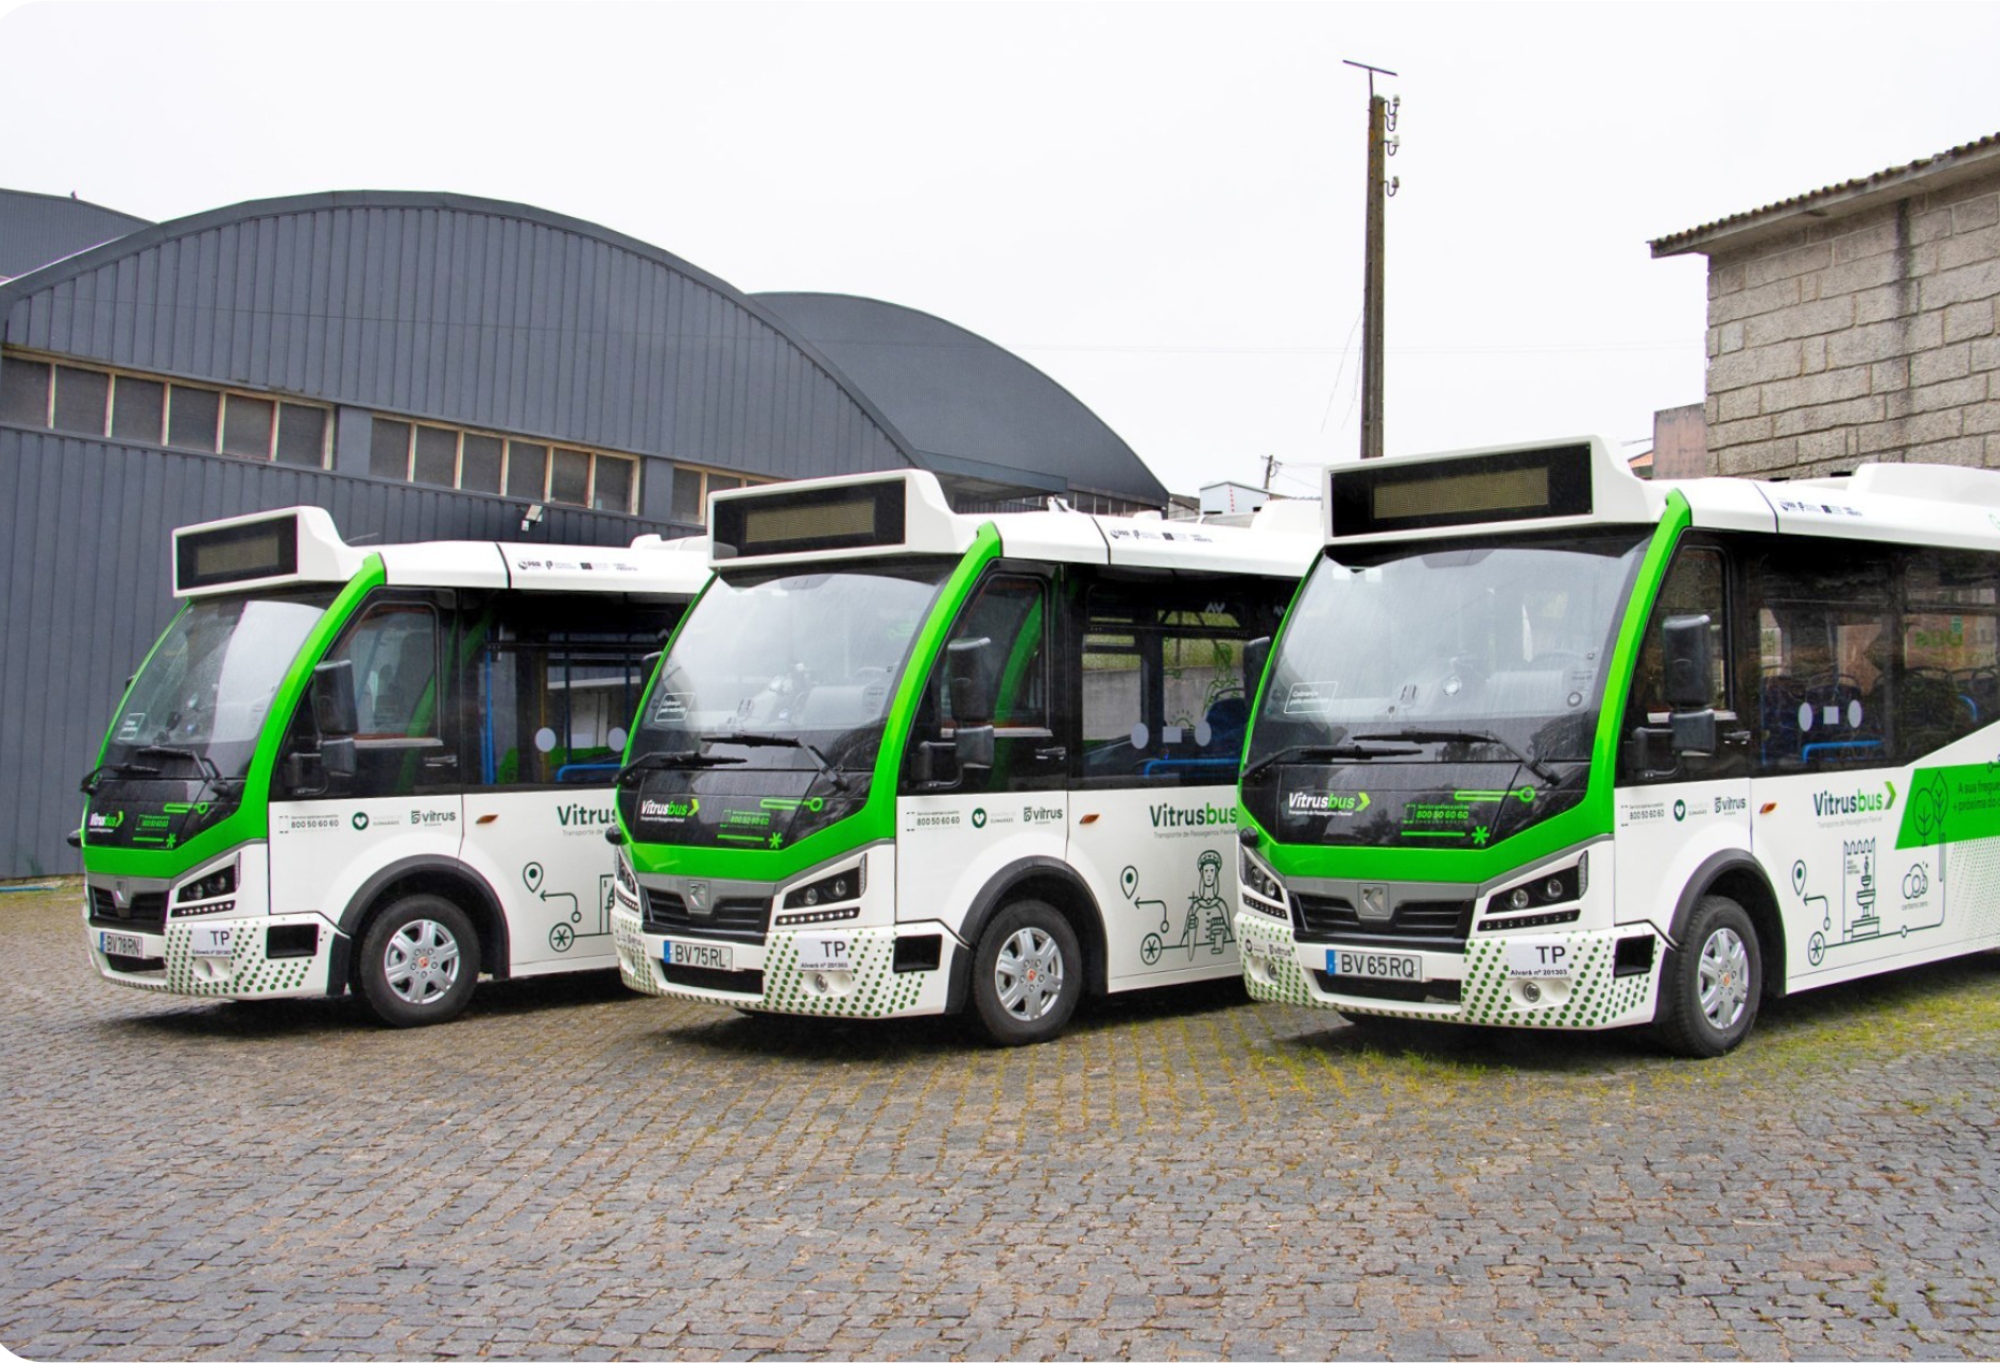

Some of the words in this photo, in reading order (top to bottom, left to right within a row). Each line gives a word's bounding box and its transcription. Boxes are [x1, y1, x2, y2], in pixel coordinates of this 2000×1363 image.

[641, 799, 688, 816] Vitrusbus
[1289, 792, 1355, 809] Vitrusbus
[1813, 788, 1883, 817] Vitrusbus
[917, 817, 930, 826] 800
[931, 817, 940, 825] 50
[941, 816, 950, 825] 60
[951, 816, 960, 824] 60
[1149, 802, 1238, 828] Vitrusbus
[291, 820, 306, 829] 800
[307, 820, 317, 828] 50
[318, 820, 328, 828] 60
[329, 819, 339, 827] 60
[210, 931, 230, 946] TP
[675, 944, 726, 968] BV75RL
[820, 941, 846, 958] TP
[1535, 945, 1566, 964] TP
[1341, 953, 1414, 978] BV65RQ
